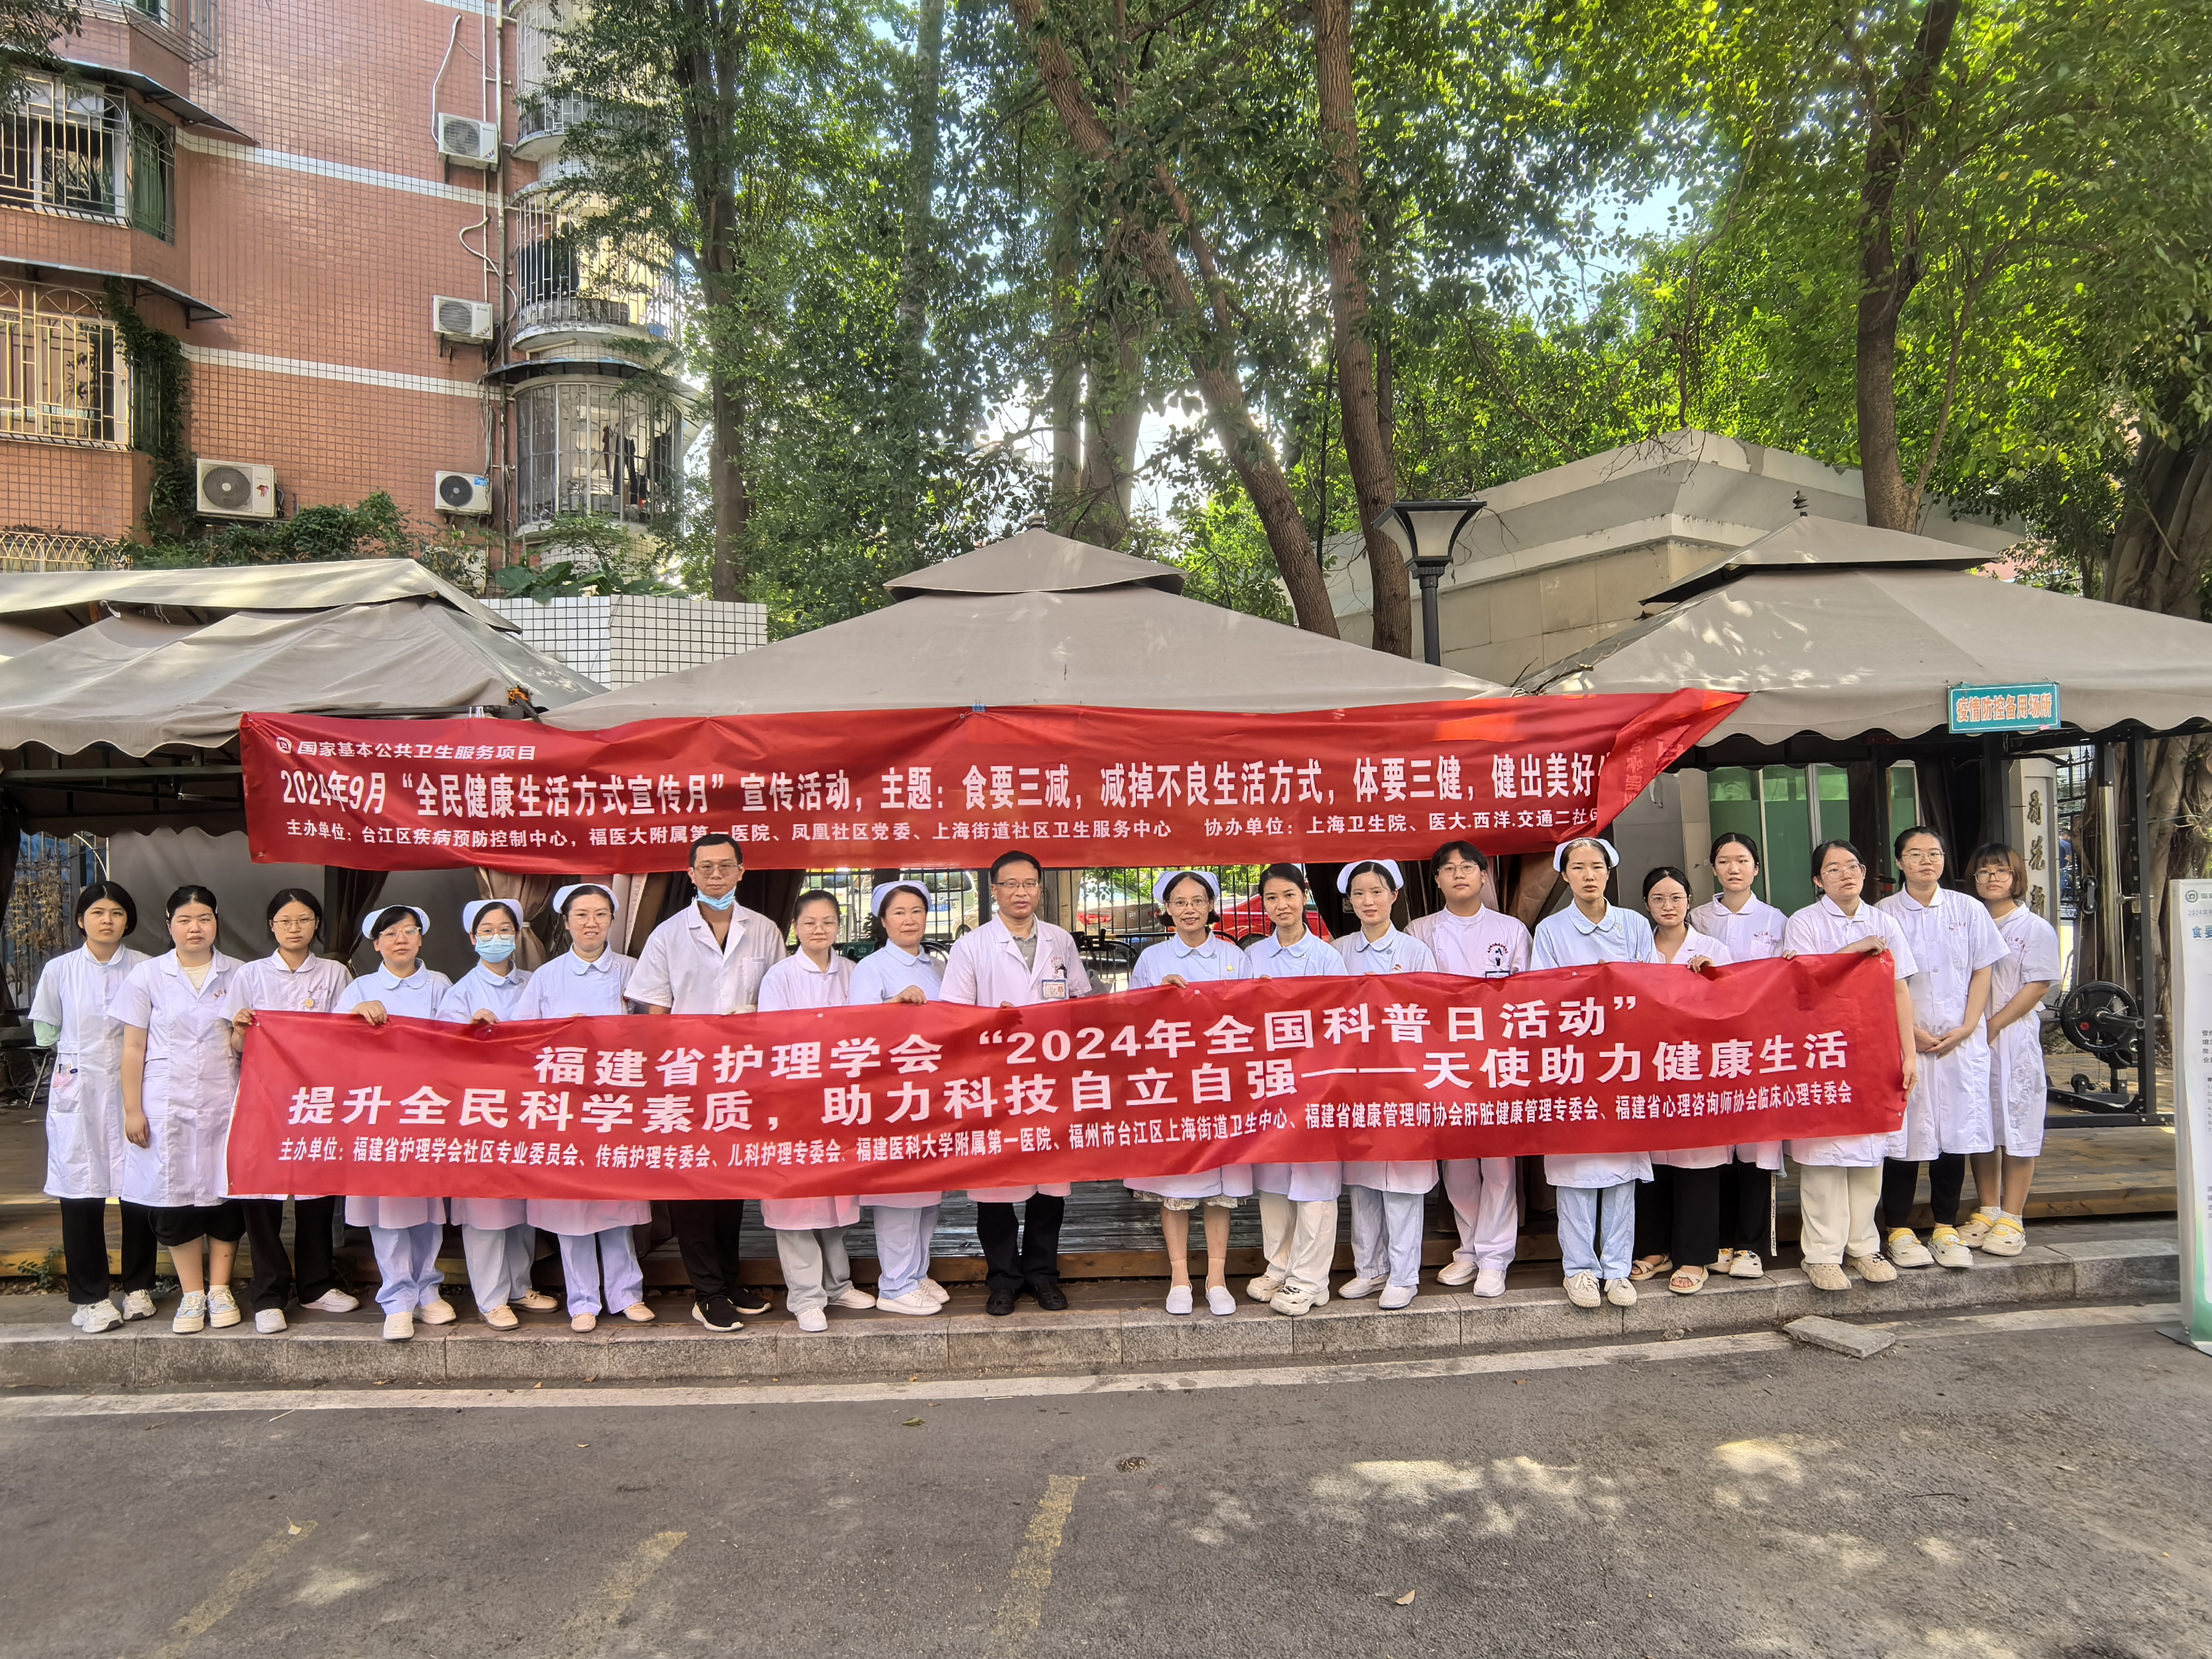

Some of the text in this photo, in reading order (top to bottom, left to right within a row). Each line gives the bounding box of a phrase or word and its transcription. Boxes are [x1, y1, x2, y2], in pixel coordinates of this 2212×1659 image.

[1956, 692, 2052, 723] 疫情防控备用场所
[297, 741, 536, 761] 国家基本公共卫生服务项目
